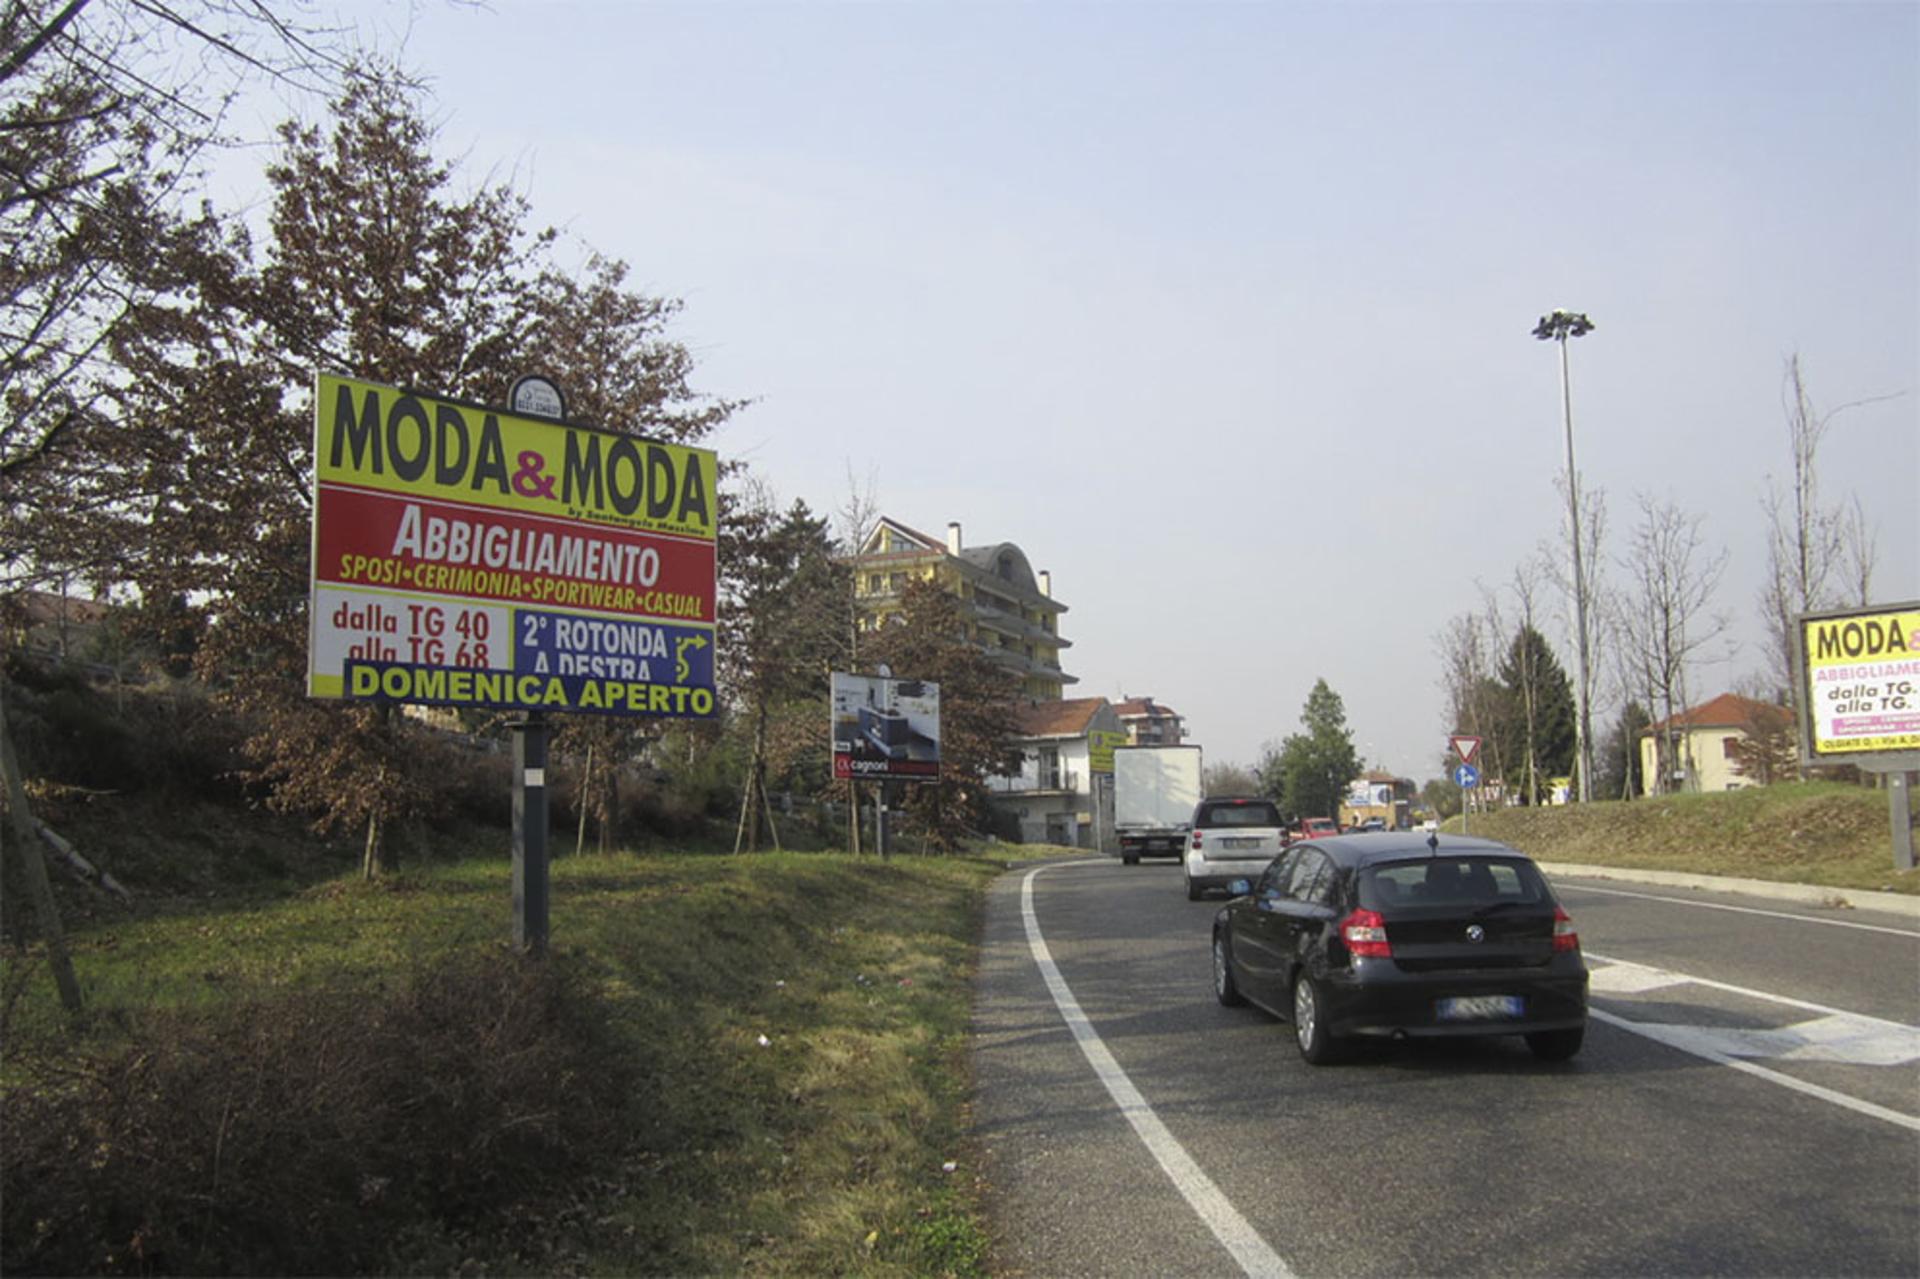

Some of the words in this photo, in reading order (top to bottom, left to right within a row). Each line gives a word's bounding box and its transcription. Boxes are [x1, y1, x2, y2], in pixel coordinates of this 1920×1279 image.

[392, 504, 660, 587] ABBIGLIAMENTO
[333, 601, 397, 633] dalla
[407, 605, 445, 637] TG
[455, 609, 490, 641] 40
[555, 618, 668, 658] ROTONDA
[349, 637, 396, 661] alla
[407, 637, 445, 665] TG
[455, 641, 489, 669] 68
[534, 651, 550, 673] A
[352, 665, 568, 705] DOMENICA
[578, 680, 714, 715] APERTO
[1835, 700, 1873, 713] alla
